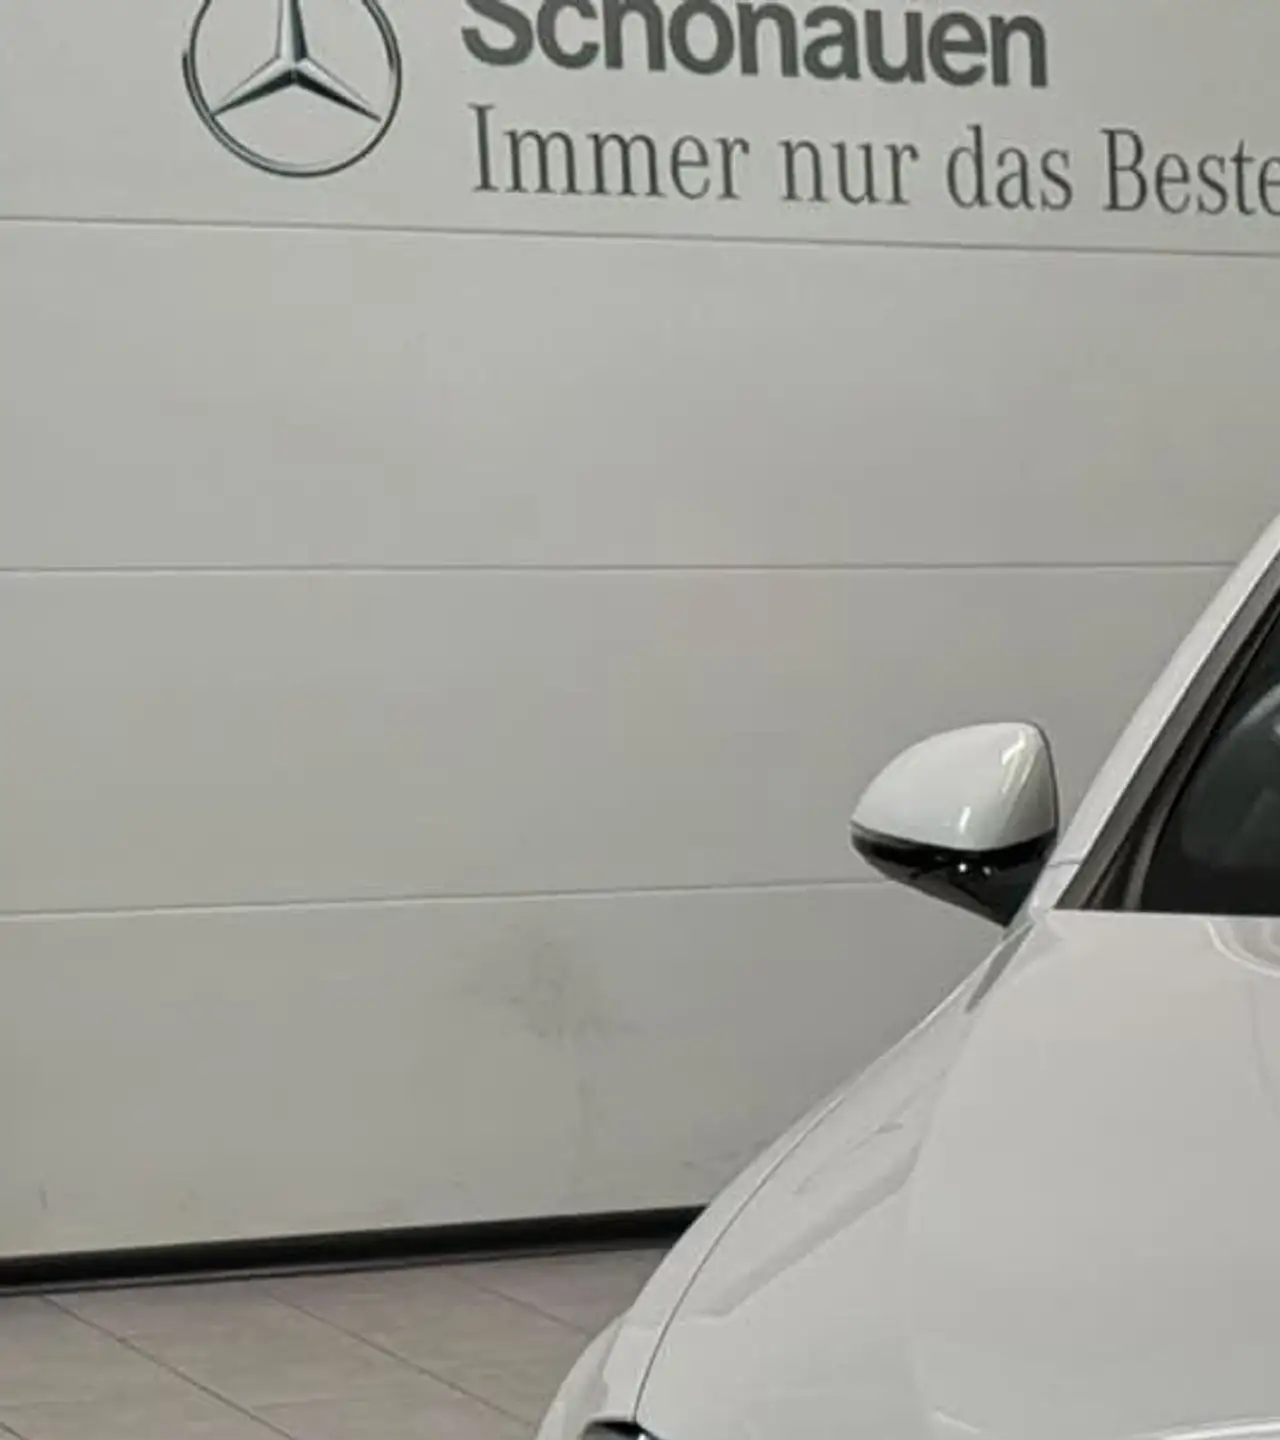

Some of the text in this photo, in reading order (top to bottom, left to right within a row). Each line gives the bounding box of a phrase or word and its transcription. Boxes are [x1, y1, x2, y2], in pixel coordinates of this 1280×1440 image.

[469, 102, 750, 199] Immer
[777, 137, 920, 206] nur
[946, 123, 1075, 211] das
